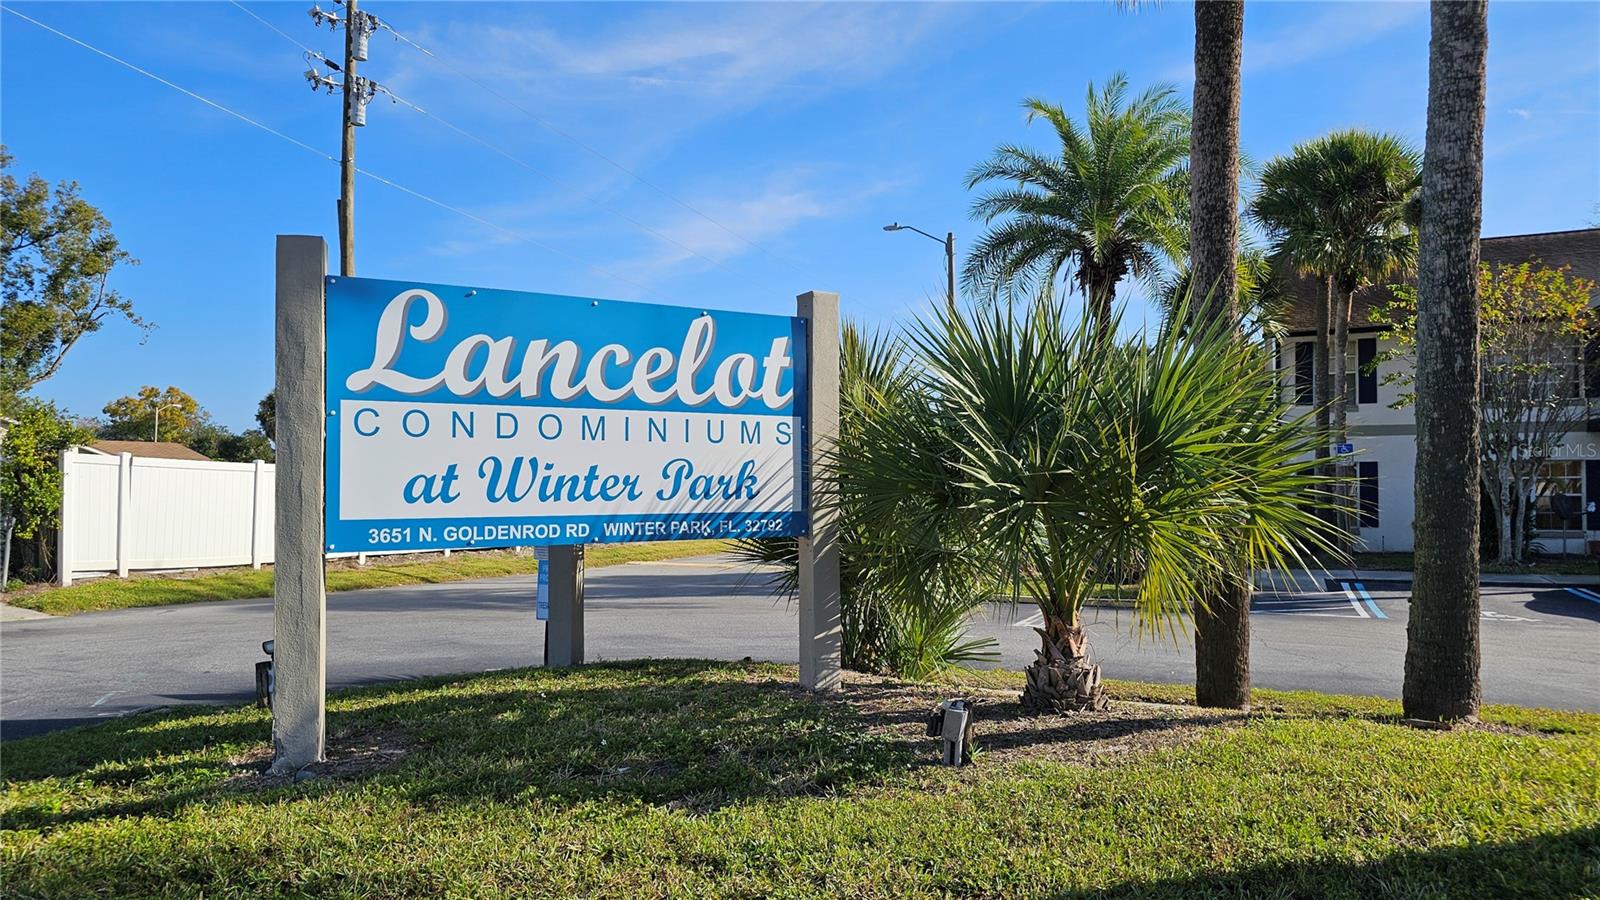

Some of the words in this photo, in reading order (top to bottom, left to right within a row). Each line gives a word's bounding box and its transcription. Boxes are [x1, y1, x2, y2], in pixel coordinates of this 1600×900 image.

[346, 288, 794, 410] Lancelot
[353, 407, 793, 446] CONDOMINIUMS
[403, 463, 460, 504] at
[478, 456, 643, 504] Winter
[656, 458, 760, 502] Park
[368, 527, 411, 544] 3651
[419, 527, 437, 542] N.
[444, 524, 561, 542] GOLDENROD
[566, 523, 590, 538] RD
[604, 521, 666, 536] WINTER
[670, 520, 715, 536] PARK,
[720, 520, 741, 533] FL.
[744, 518, 783, 532] 32792
